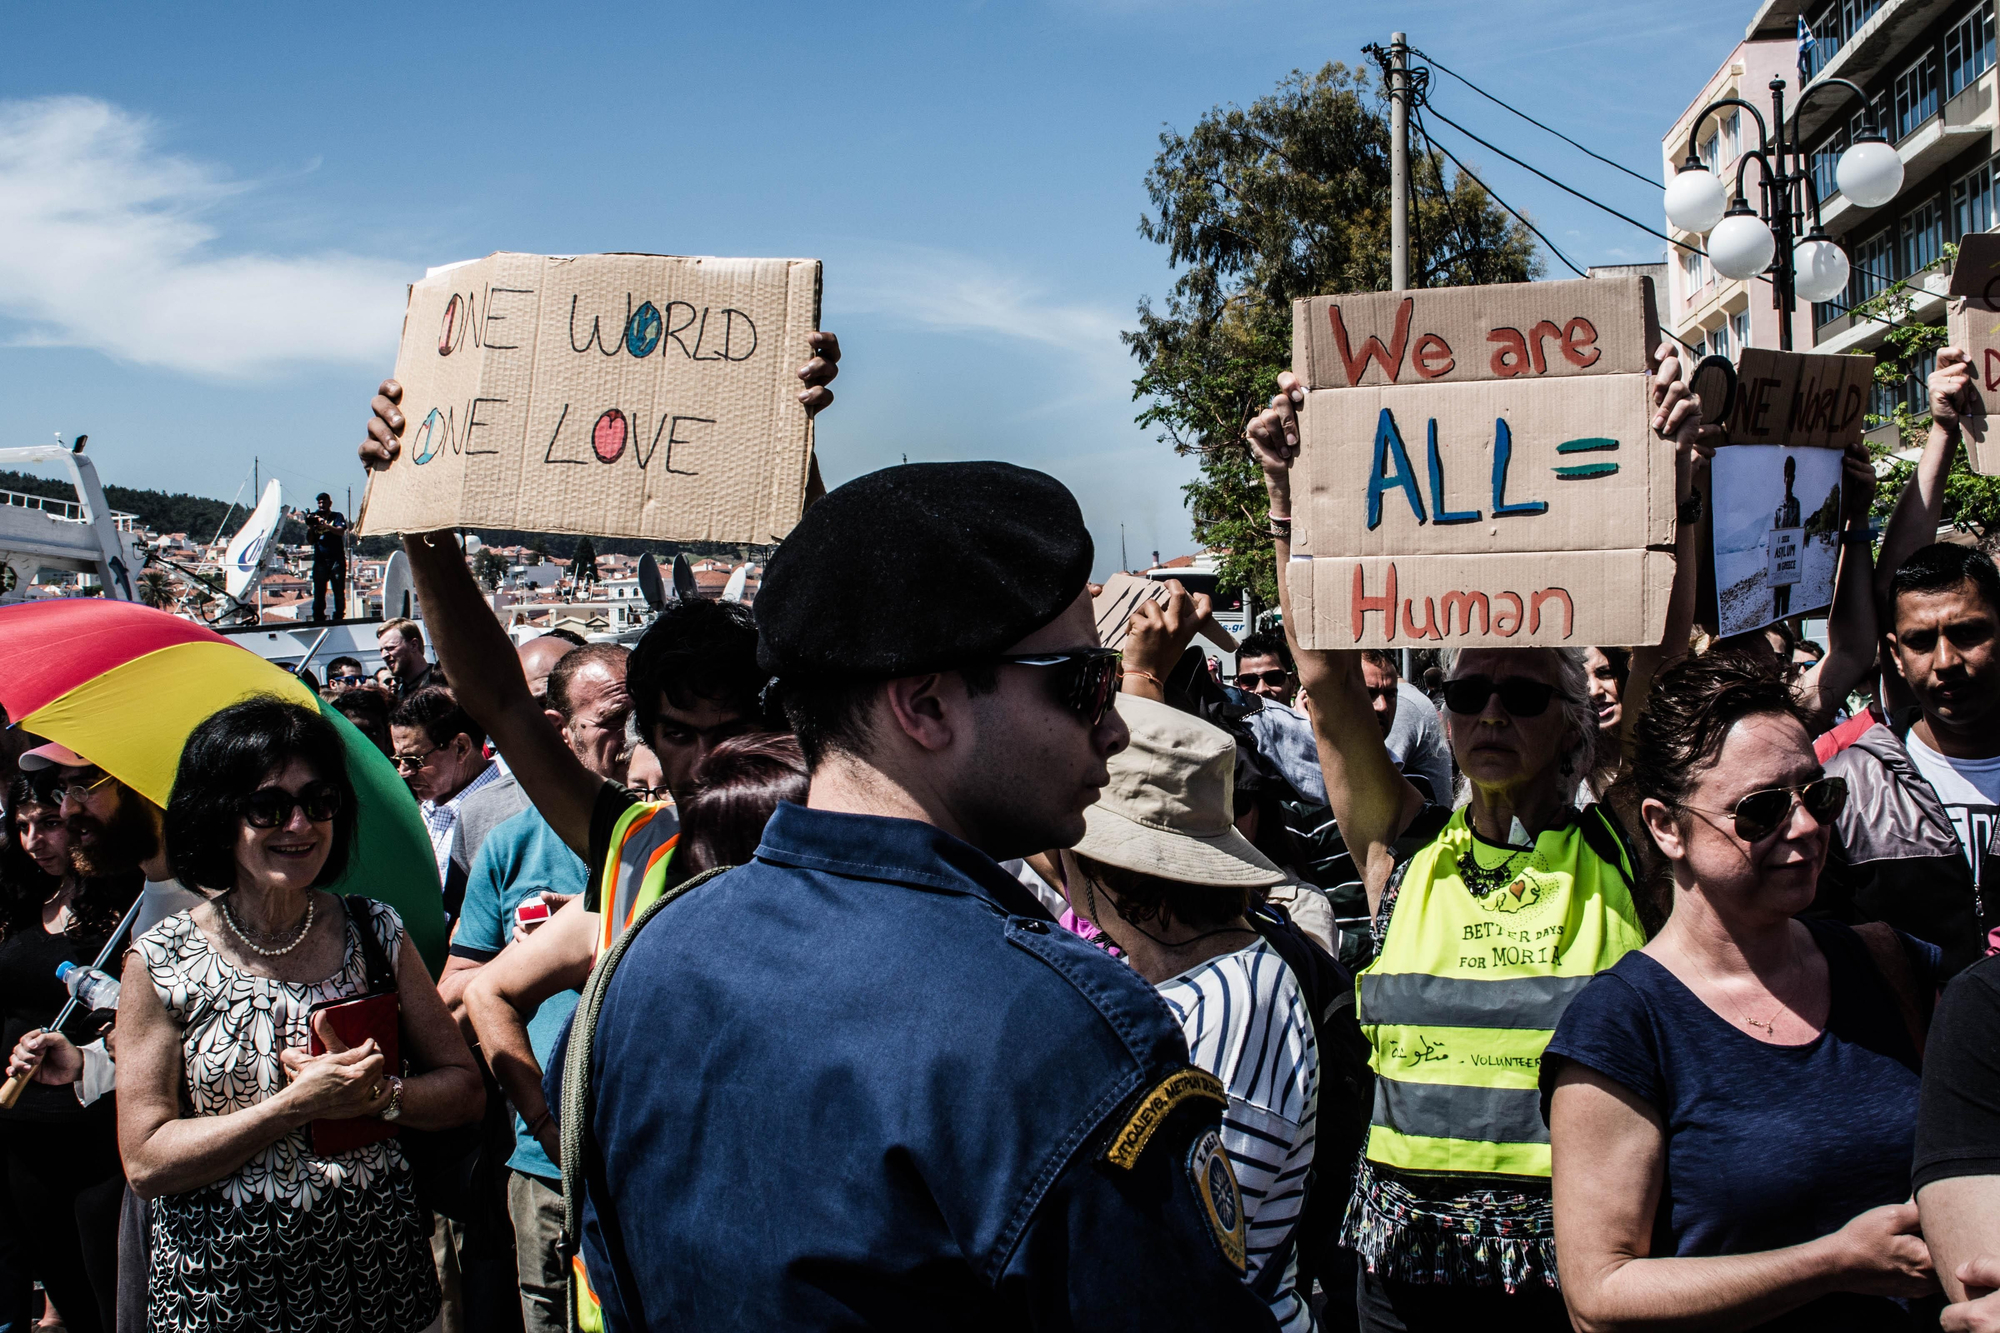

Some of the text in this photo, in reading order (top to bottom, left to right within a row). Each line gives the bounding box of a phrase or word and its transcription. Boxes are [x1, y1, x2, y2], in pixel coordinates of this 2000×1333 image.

[438, 282, 758, 362] ONE WORLD
[1328, 297, 1601, 386] We are
[1689, 355, 1862, 436] ONE WORLD
[412, 398, 716, 475] ONE LOVE
[1351, 562, 1575, 643] Human
[1459, 945, 1563, 969] FOR MORIA
[1462, 922, 1564, 943] BETTER DAYS
